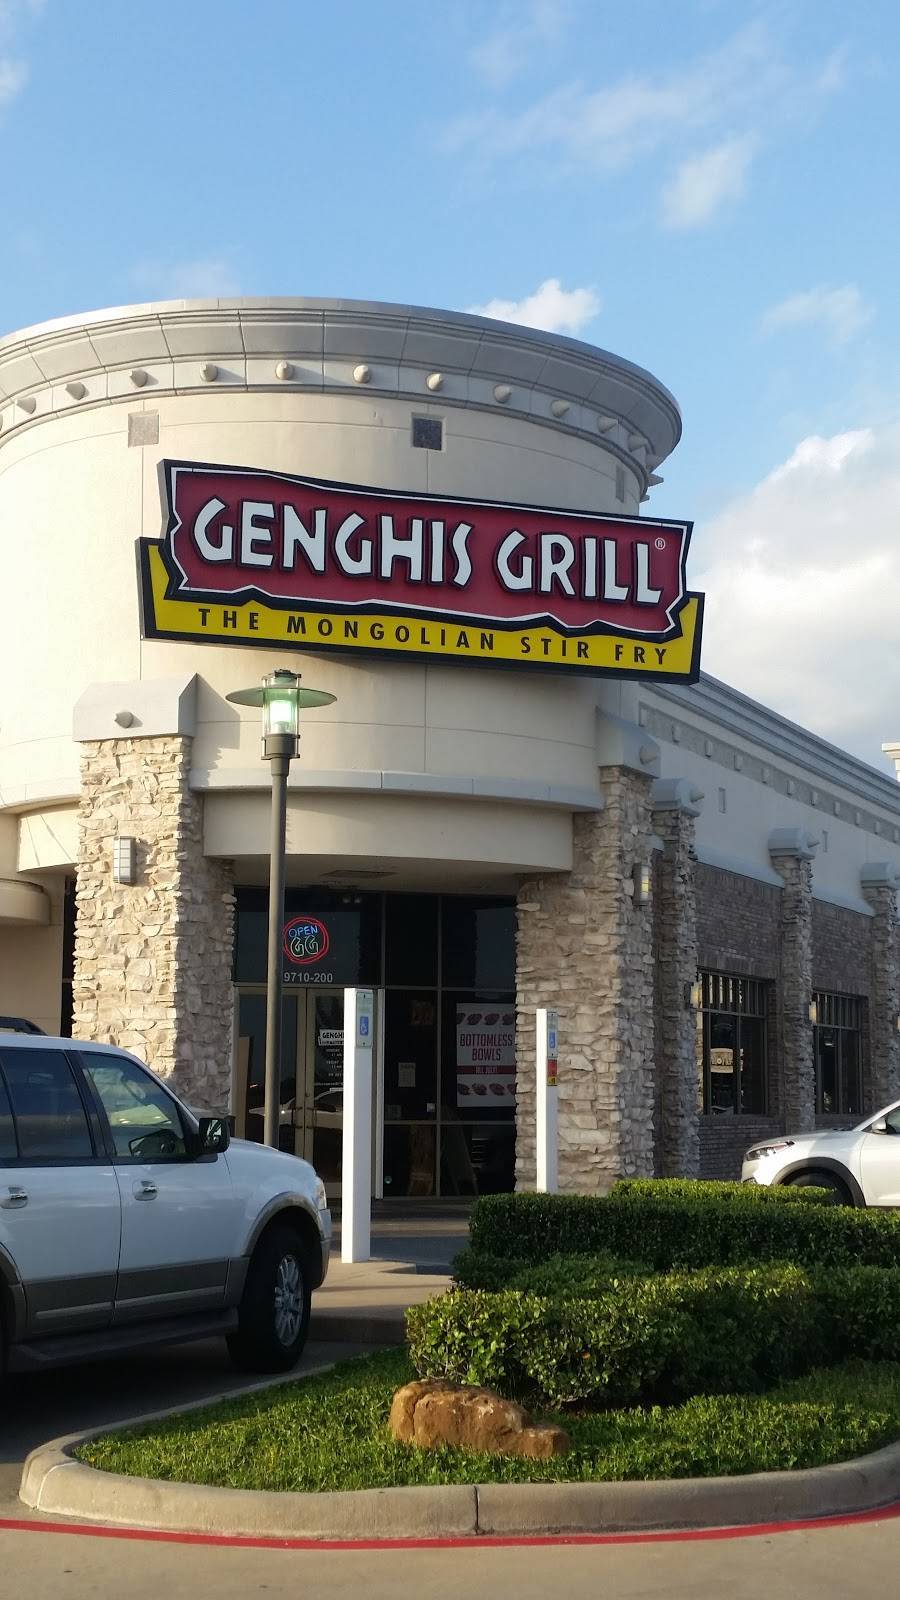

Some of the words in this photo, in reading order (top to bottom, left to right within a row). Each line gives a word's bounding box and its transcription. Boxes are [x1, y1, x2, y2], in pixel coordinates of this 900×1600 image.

[193, 497, 473, 587] GENGHIS
[496, 529, 662, 604] GRILL
[198, 608, 260, 630] THE
[286, 615, 495, 651] MONGOLIAN
[520, 636, 590, 660] STIR
[615, 644, 667, 665] FRY
[288, 925, 318, 938] OPEN
[284, 972, 333, 983] 9710-200
[460, 1033, 513, 1047] BOTTOMLESS
[471, 1049, 502, 1062] BOWLS
